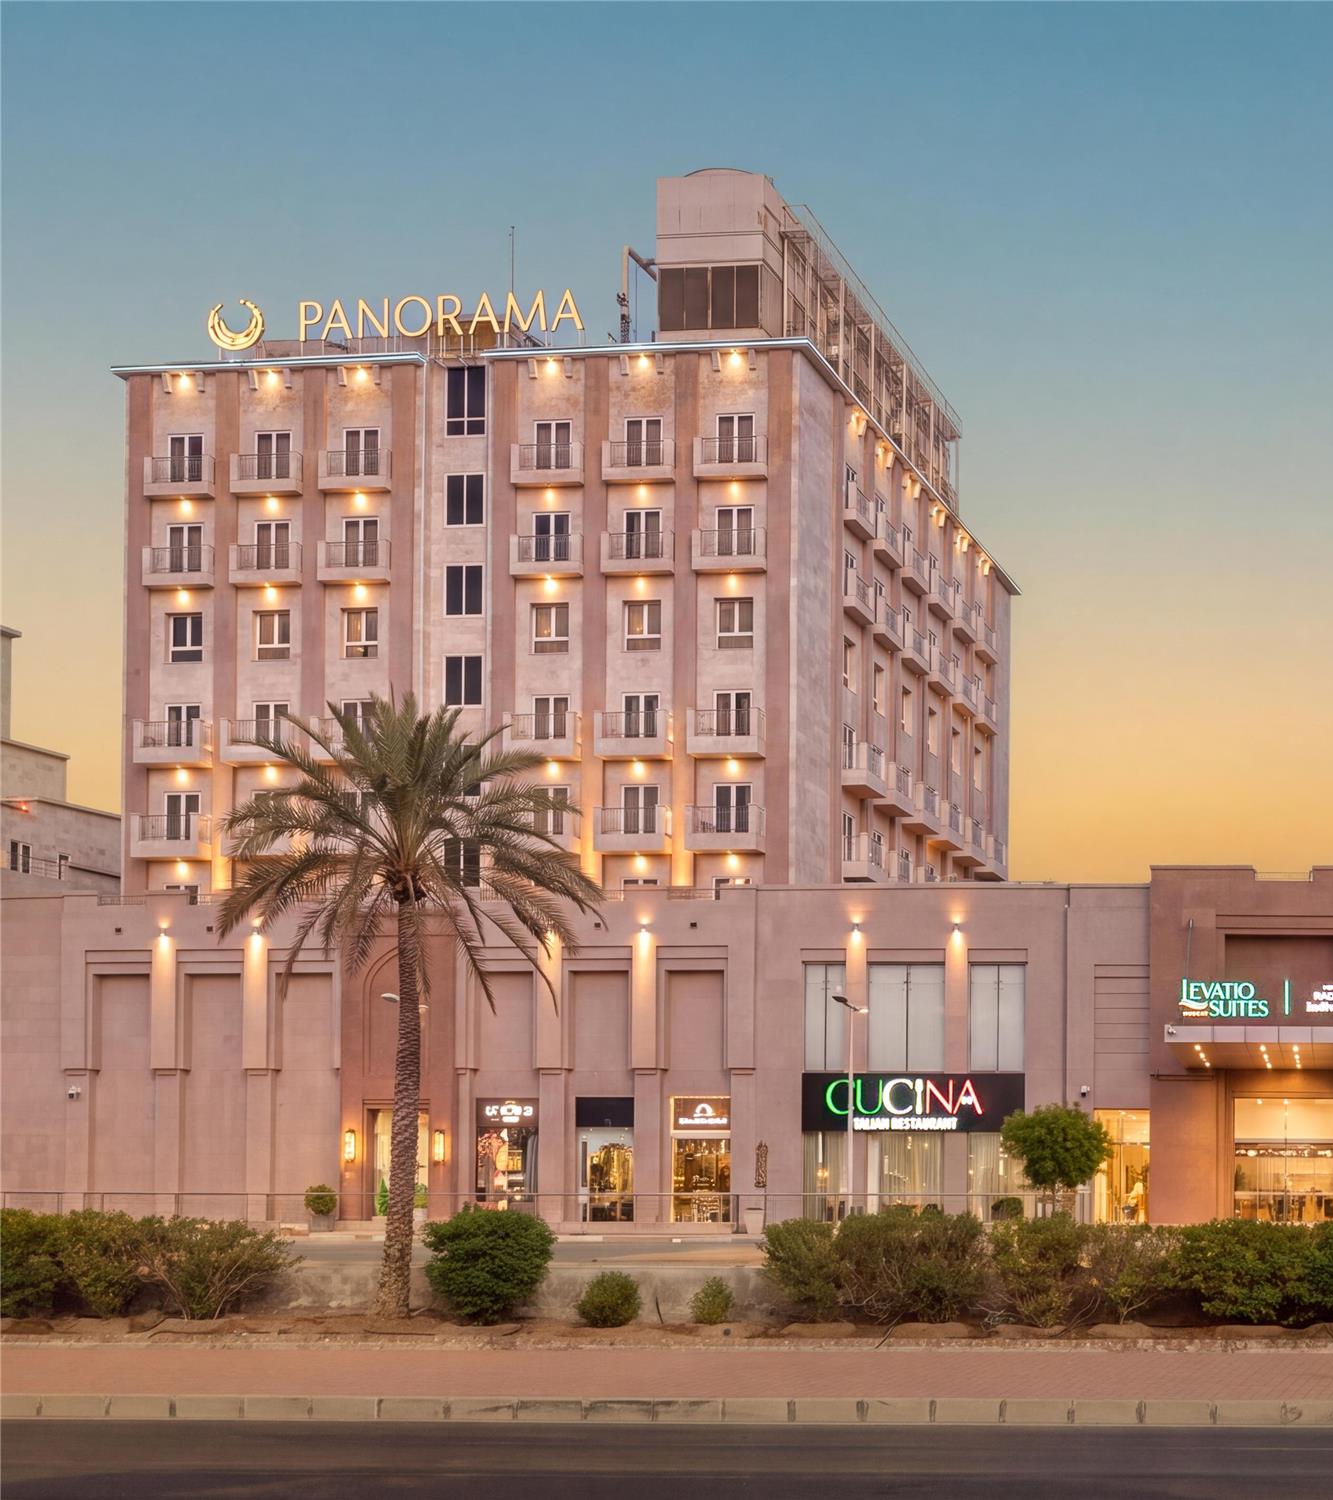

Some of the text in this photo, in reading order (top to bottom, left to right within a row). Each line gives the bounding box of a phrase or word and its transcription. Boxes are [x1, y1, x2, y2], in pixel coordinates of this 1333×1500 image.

[298, 287, 585, 343] PANORAMA
[1182, 978, 1255, 1001] LEVATIO
[1208, 1000, 1269, 1017] SUITES
[825, 1078, 984, 1116] CUCINA
[852, 1116, 958, 1131] TALIAN RESTAURANT
